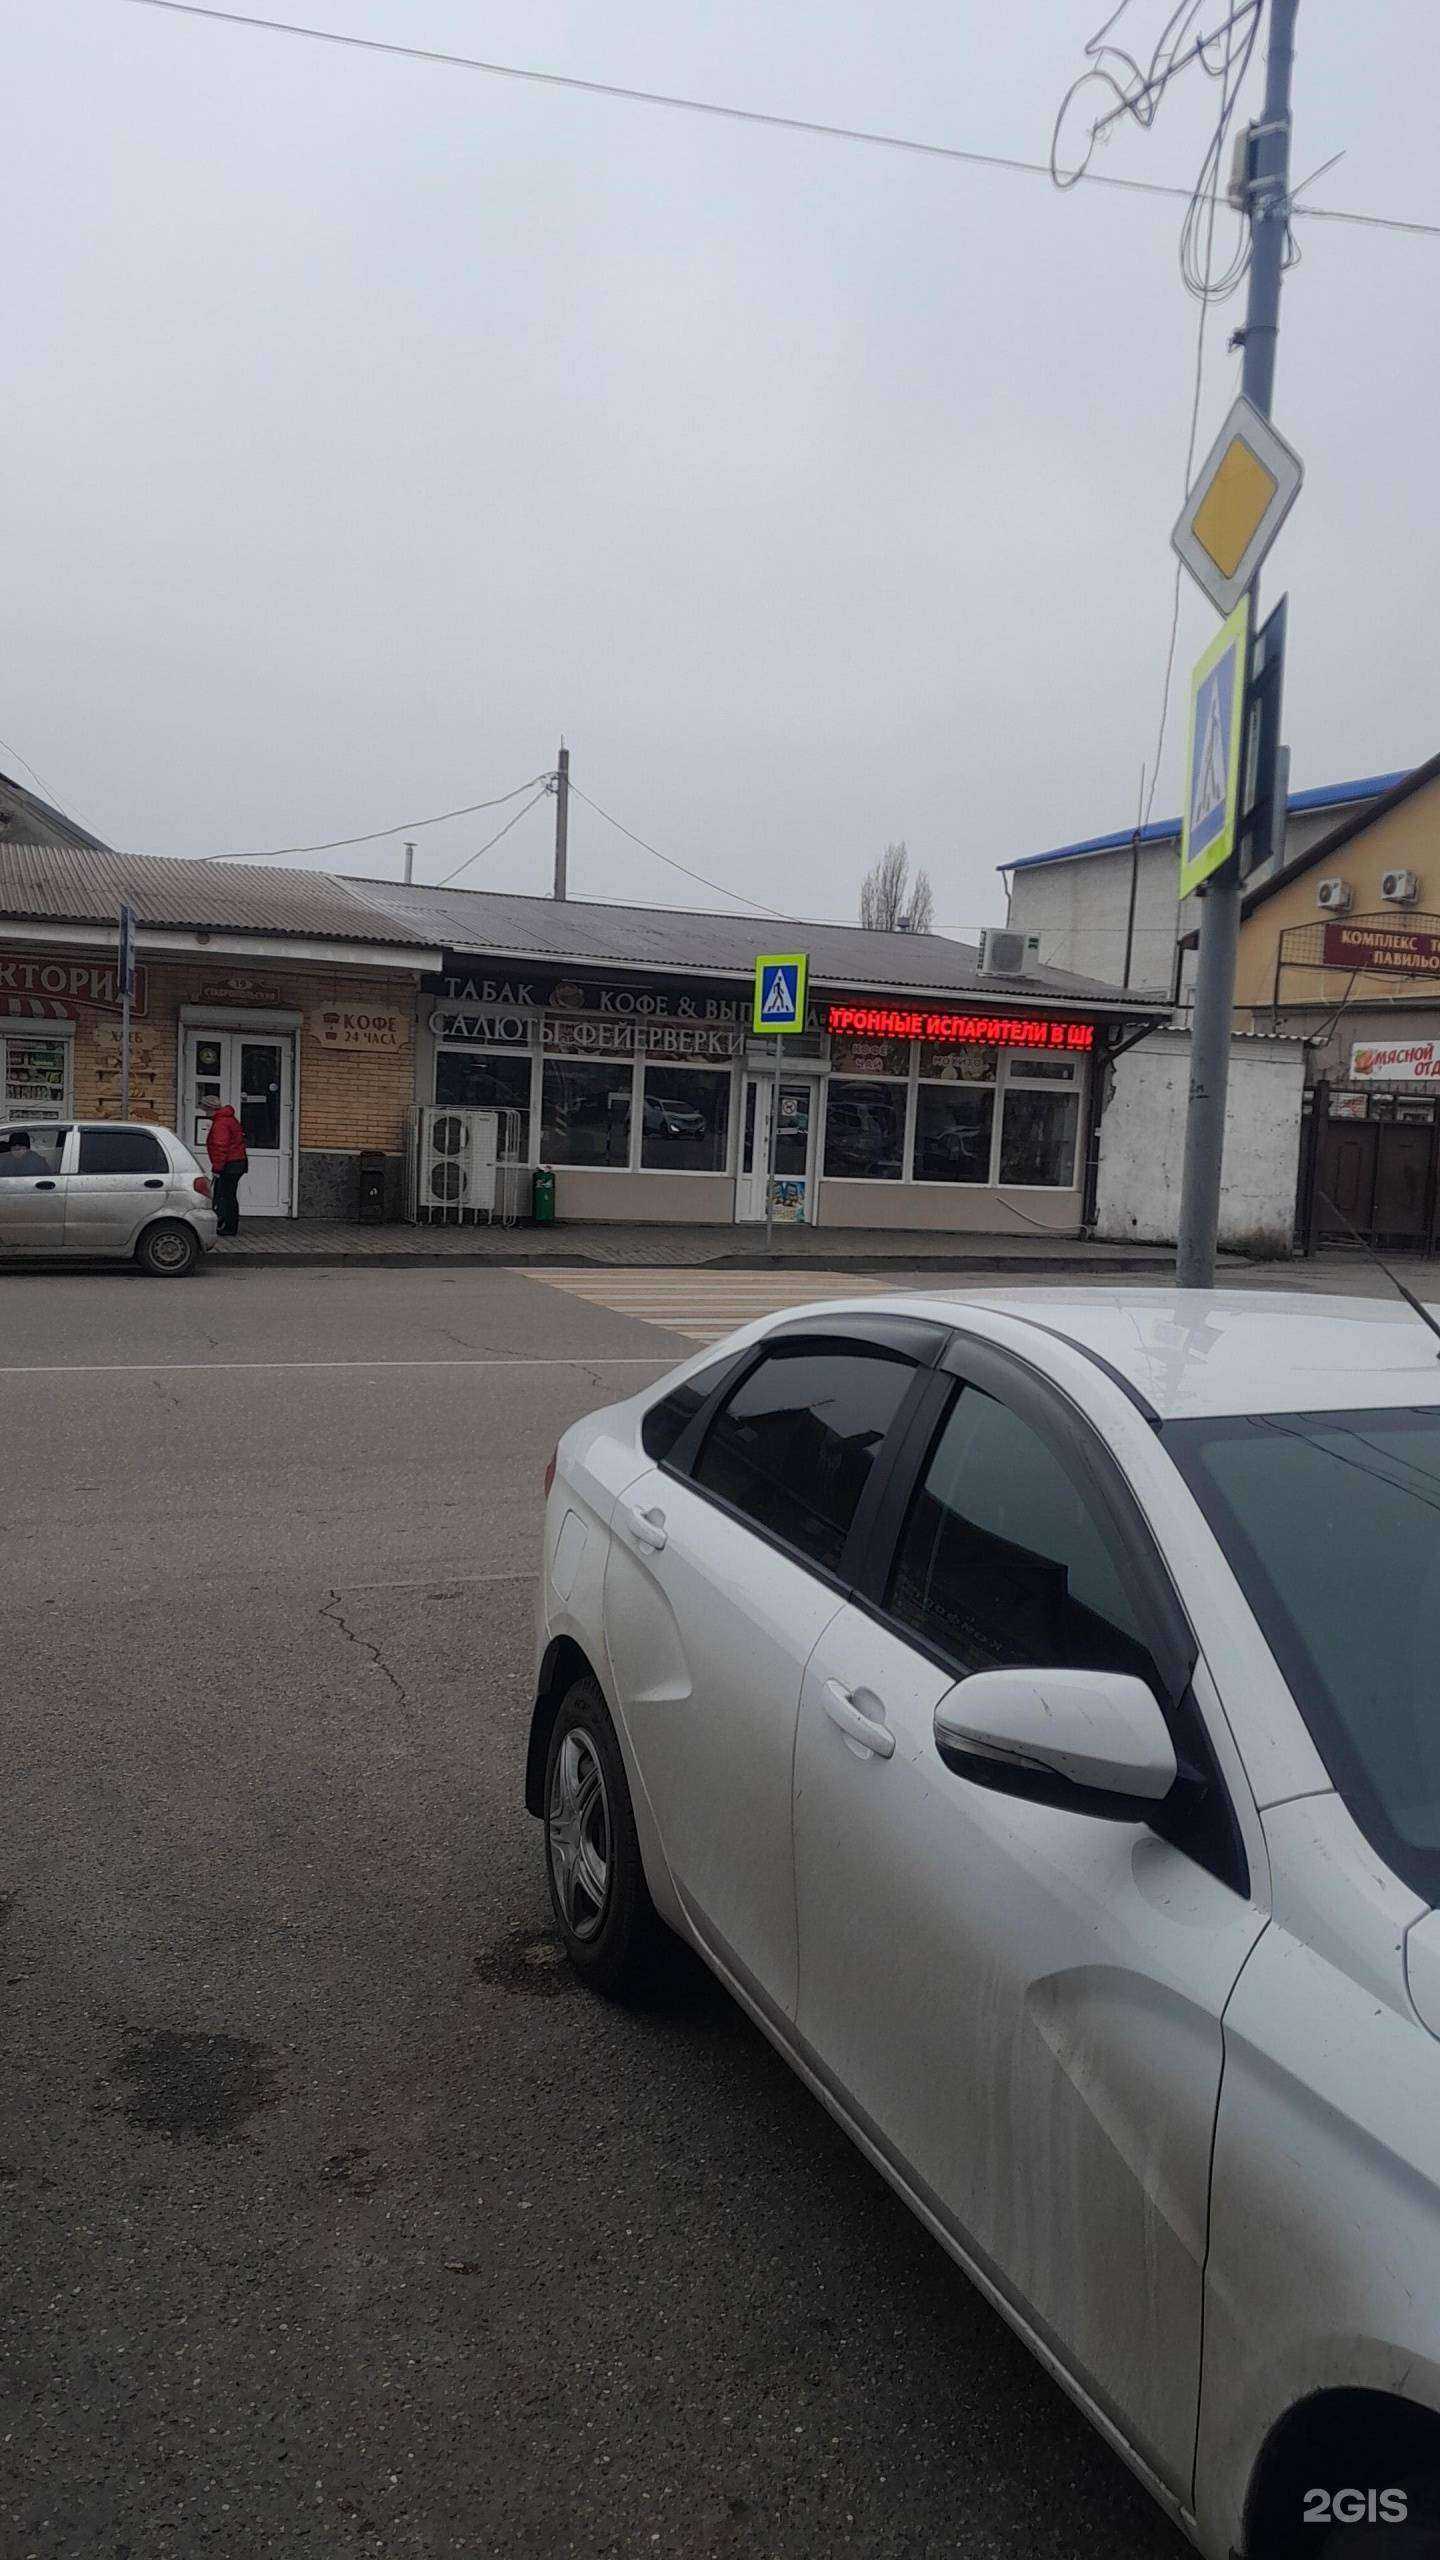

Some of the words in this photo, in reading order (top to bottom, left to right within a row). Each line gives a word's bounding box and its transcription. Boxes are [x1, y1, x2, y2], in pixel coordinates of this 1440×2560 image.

[1341, 930, 1418, 951] КОМПЛЕКС
[444, 977, 536, 1006] ТАБАК
[600, 990, 669, 1016] КОФЕ
[677, 996, 698, 1019] &
[344, 1014, 397, 1033] КОФЕ
[428, 1011, 560, 1043] САЛЮТЫ
[573, 1022, 746, 1055] ФЕЙЕРВЕРКИ
[831, 1010, 922, 1033] ТРОННЫЕ
[926, 1018, 1047, 1042] ИСПАРИТЕЛИ
[1050, 1026, 1064, 1043] В
[111, 1030, 143, 1044] ХЕБ
[344, 1032, 359, 1044] 24
[363, 1032, 396, 1046] ЧАСА
[1374, 1044, 1433, 1065] МЯСНОЙ
